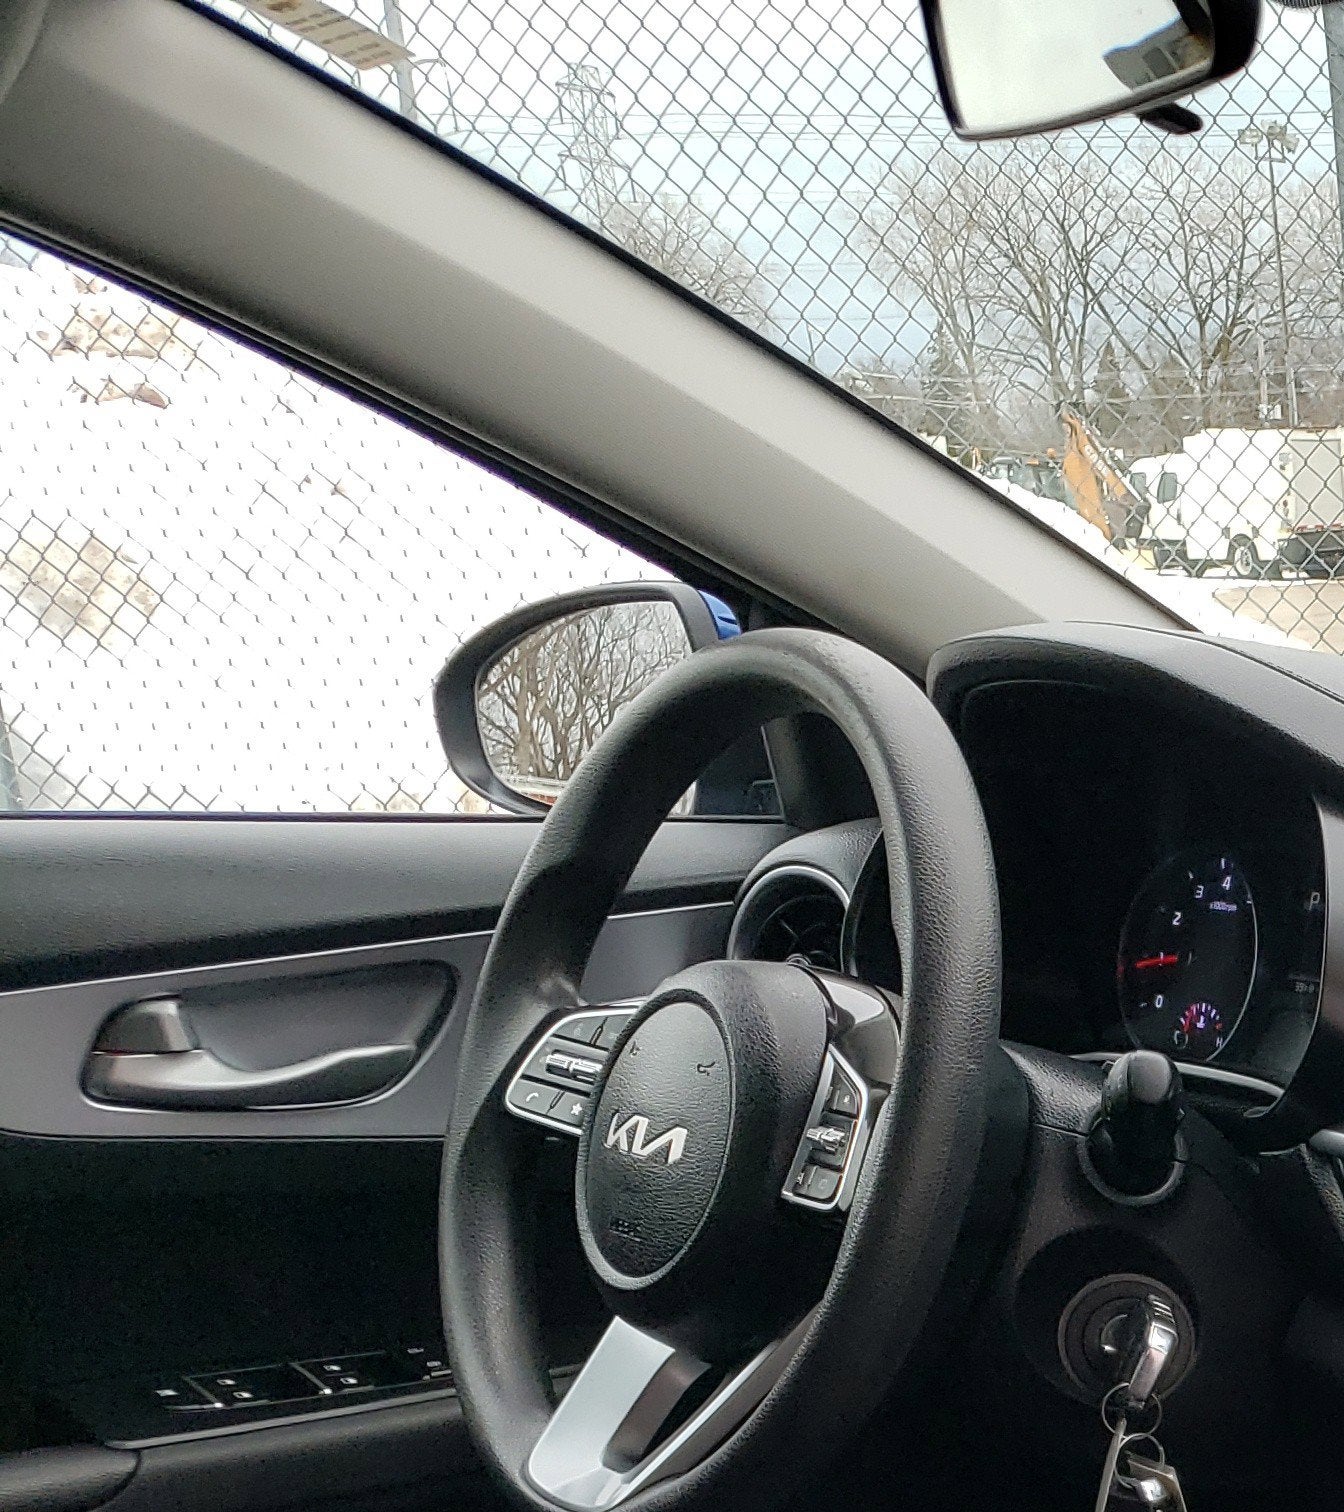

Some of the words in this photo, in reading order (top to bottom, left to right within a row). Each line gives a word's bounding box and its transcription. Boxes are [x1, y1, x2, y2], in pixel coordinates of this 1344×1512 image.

[1221, 875, 1232, 891] 4
[1195, 885, 1204, 899] 3
[1308, 891, 1321, 912] P
[1172, 912, 1182, 926] 2
[1155, 994, 1163, 1008] 0
